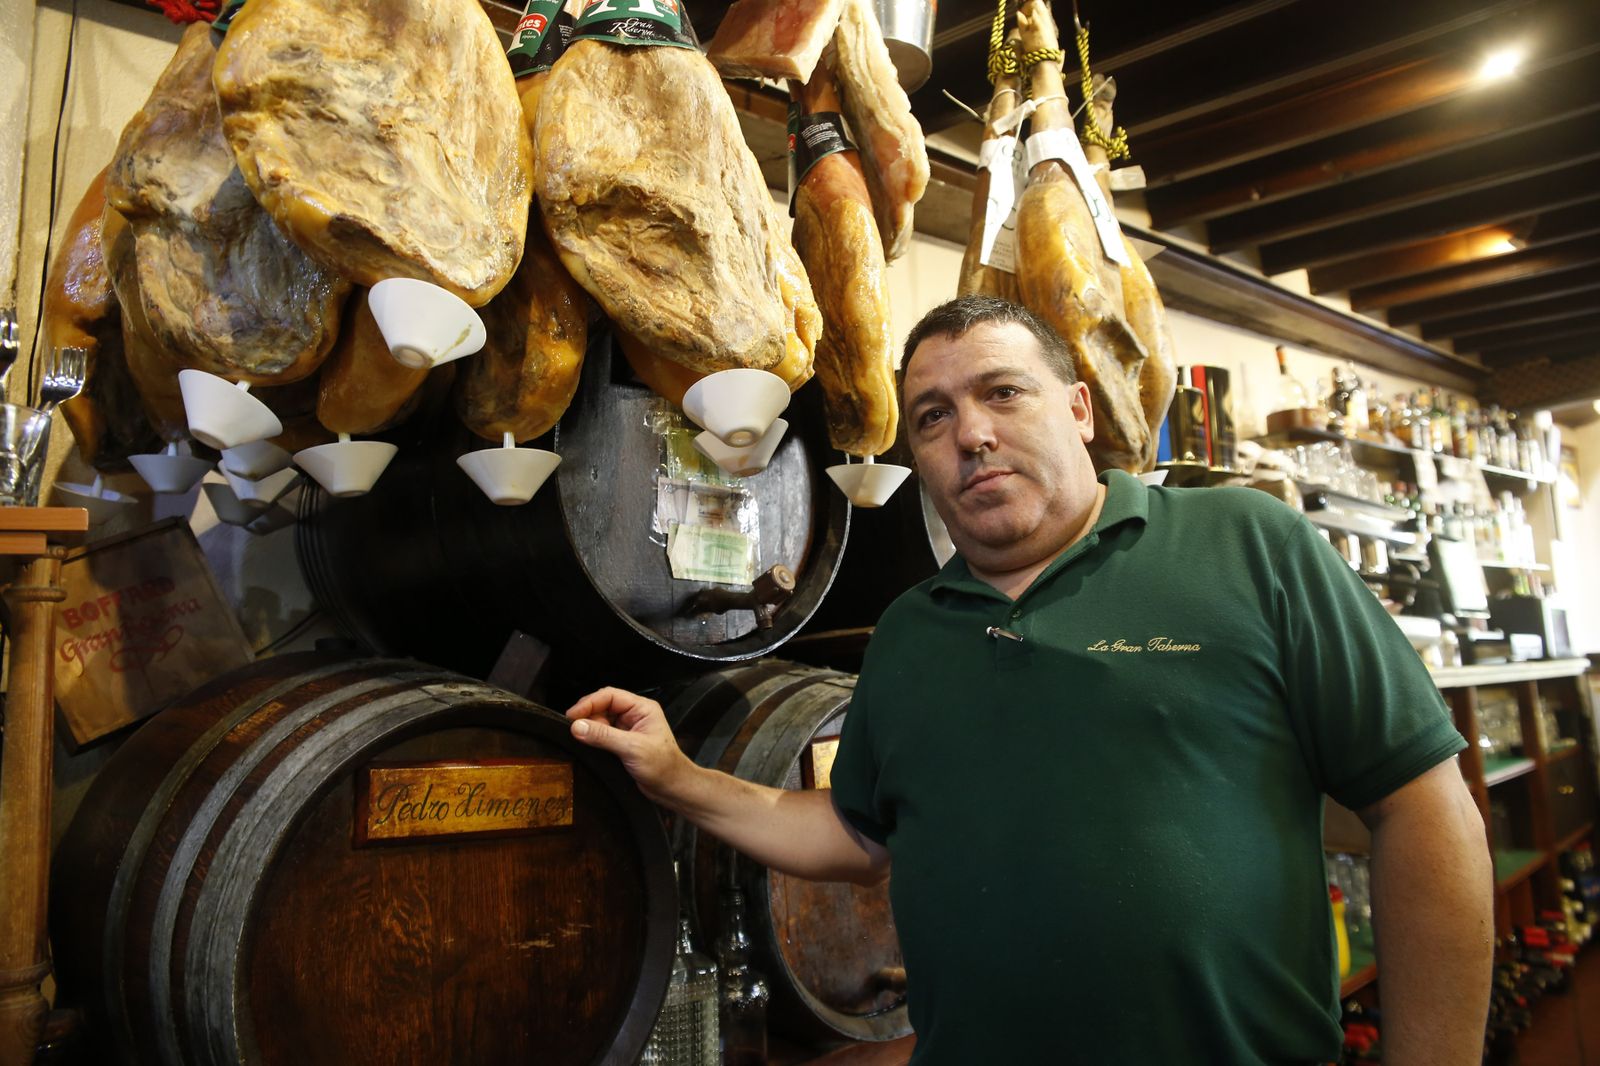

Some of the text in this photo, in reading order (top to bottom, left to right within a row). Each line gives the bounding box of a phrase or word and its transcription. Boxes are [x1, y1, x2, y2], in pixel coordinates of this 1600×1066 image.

[625, 18, 655, 28] Gran
[1087, 637, 1200, 652] La Gran Taberna
[376, 782, 568, 824] Pedro Ximenez
